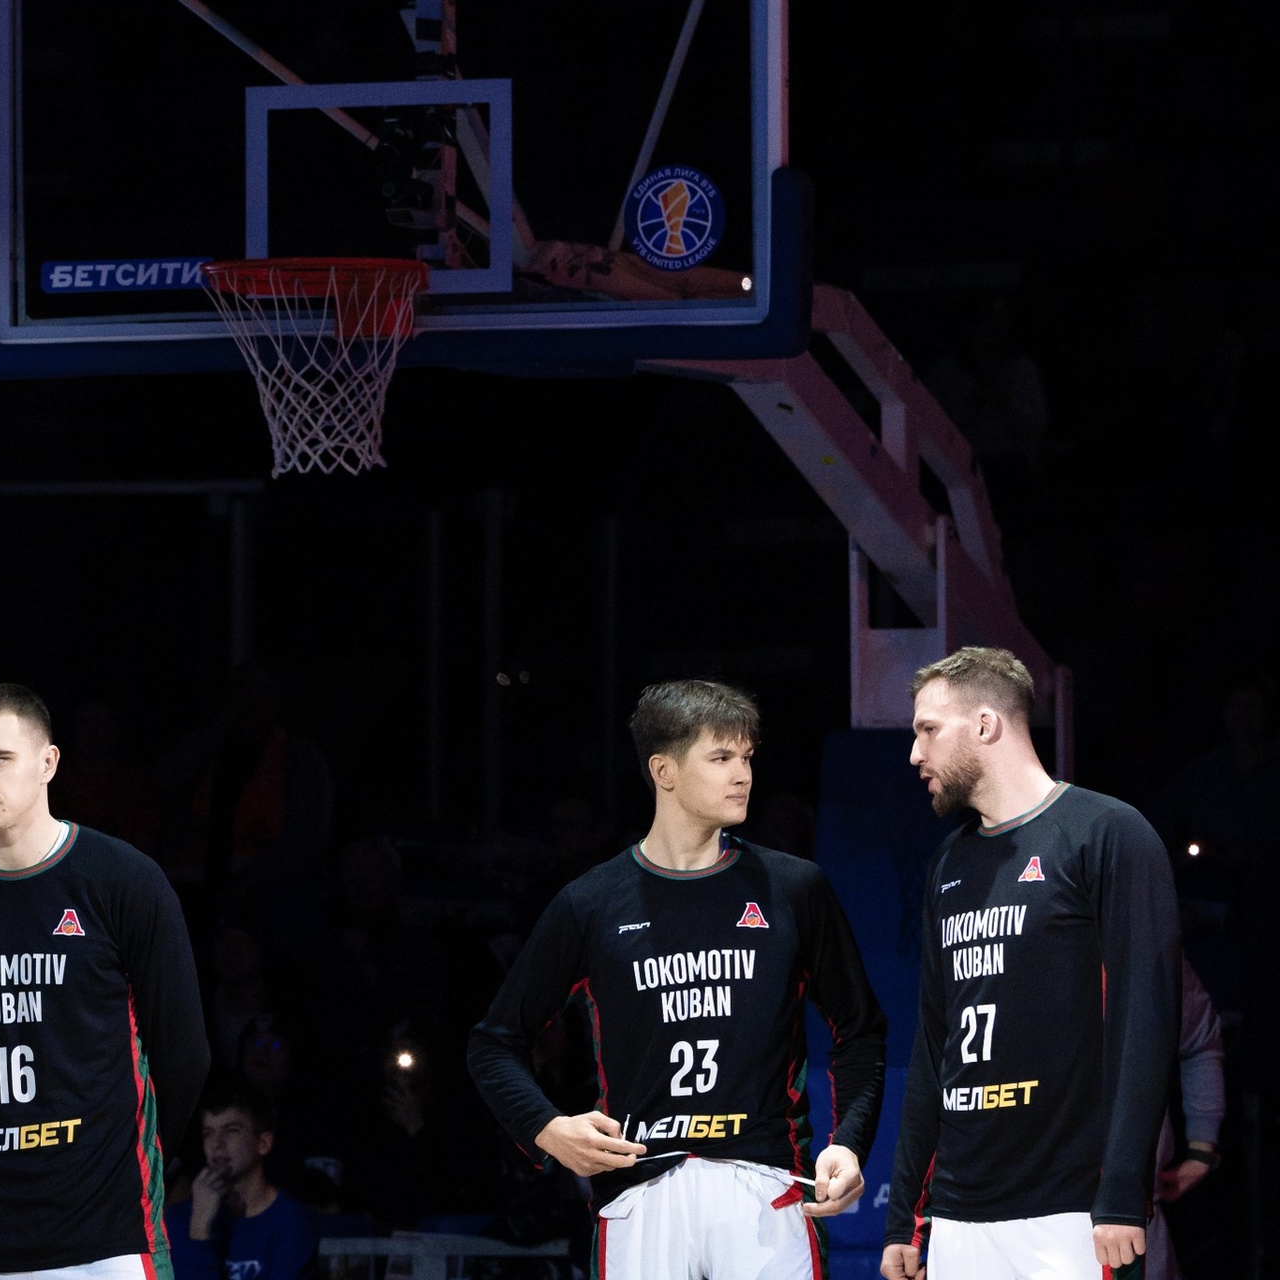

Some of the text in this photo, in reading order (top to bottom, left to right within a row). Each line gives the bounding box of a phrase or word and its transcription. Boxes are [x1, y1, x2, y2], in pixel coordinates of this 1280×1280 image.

[633, 168, 717, 200] ЕДИНАЯ ЛИГА ВТБ
[632, 236, 717, 269] VTB UNITED LEAGUE
[49, 261, 203, 288] БЕТСИТИ
[941, 904, 1027, 949] LOKOMOTIV
[632, 949, 756, 991] LOKOMOTIV
[952, 942, 1005, 981] KUBAN
[660, 985, 732, 1023] KUBAN
[960, 1003, 997, 1064] 27
[669, 1039, 720, 1097] 23
[942, 1080, 1039, 1111] МЕЛБЕТ
